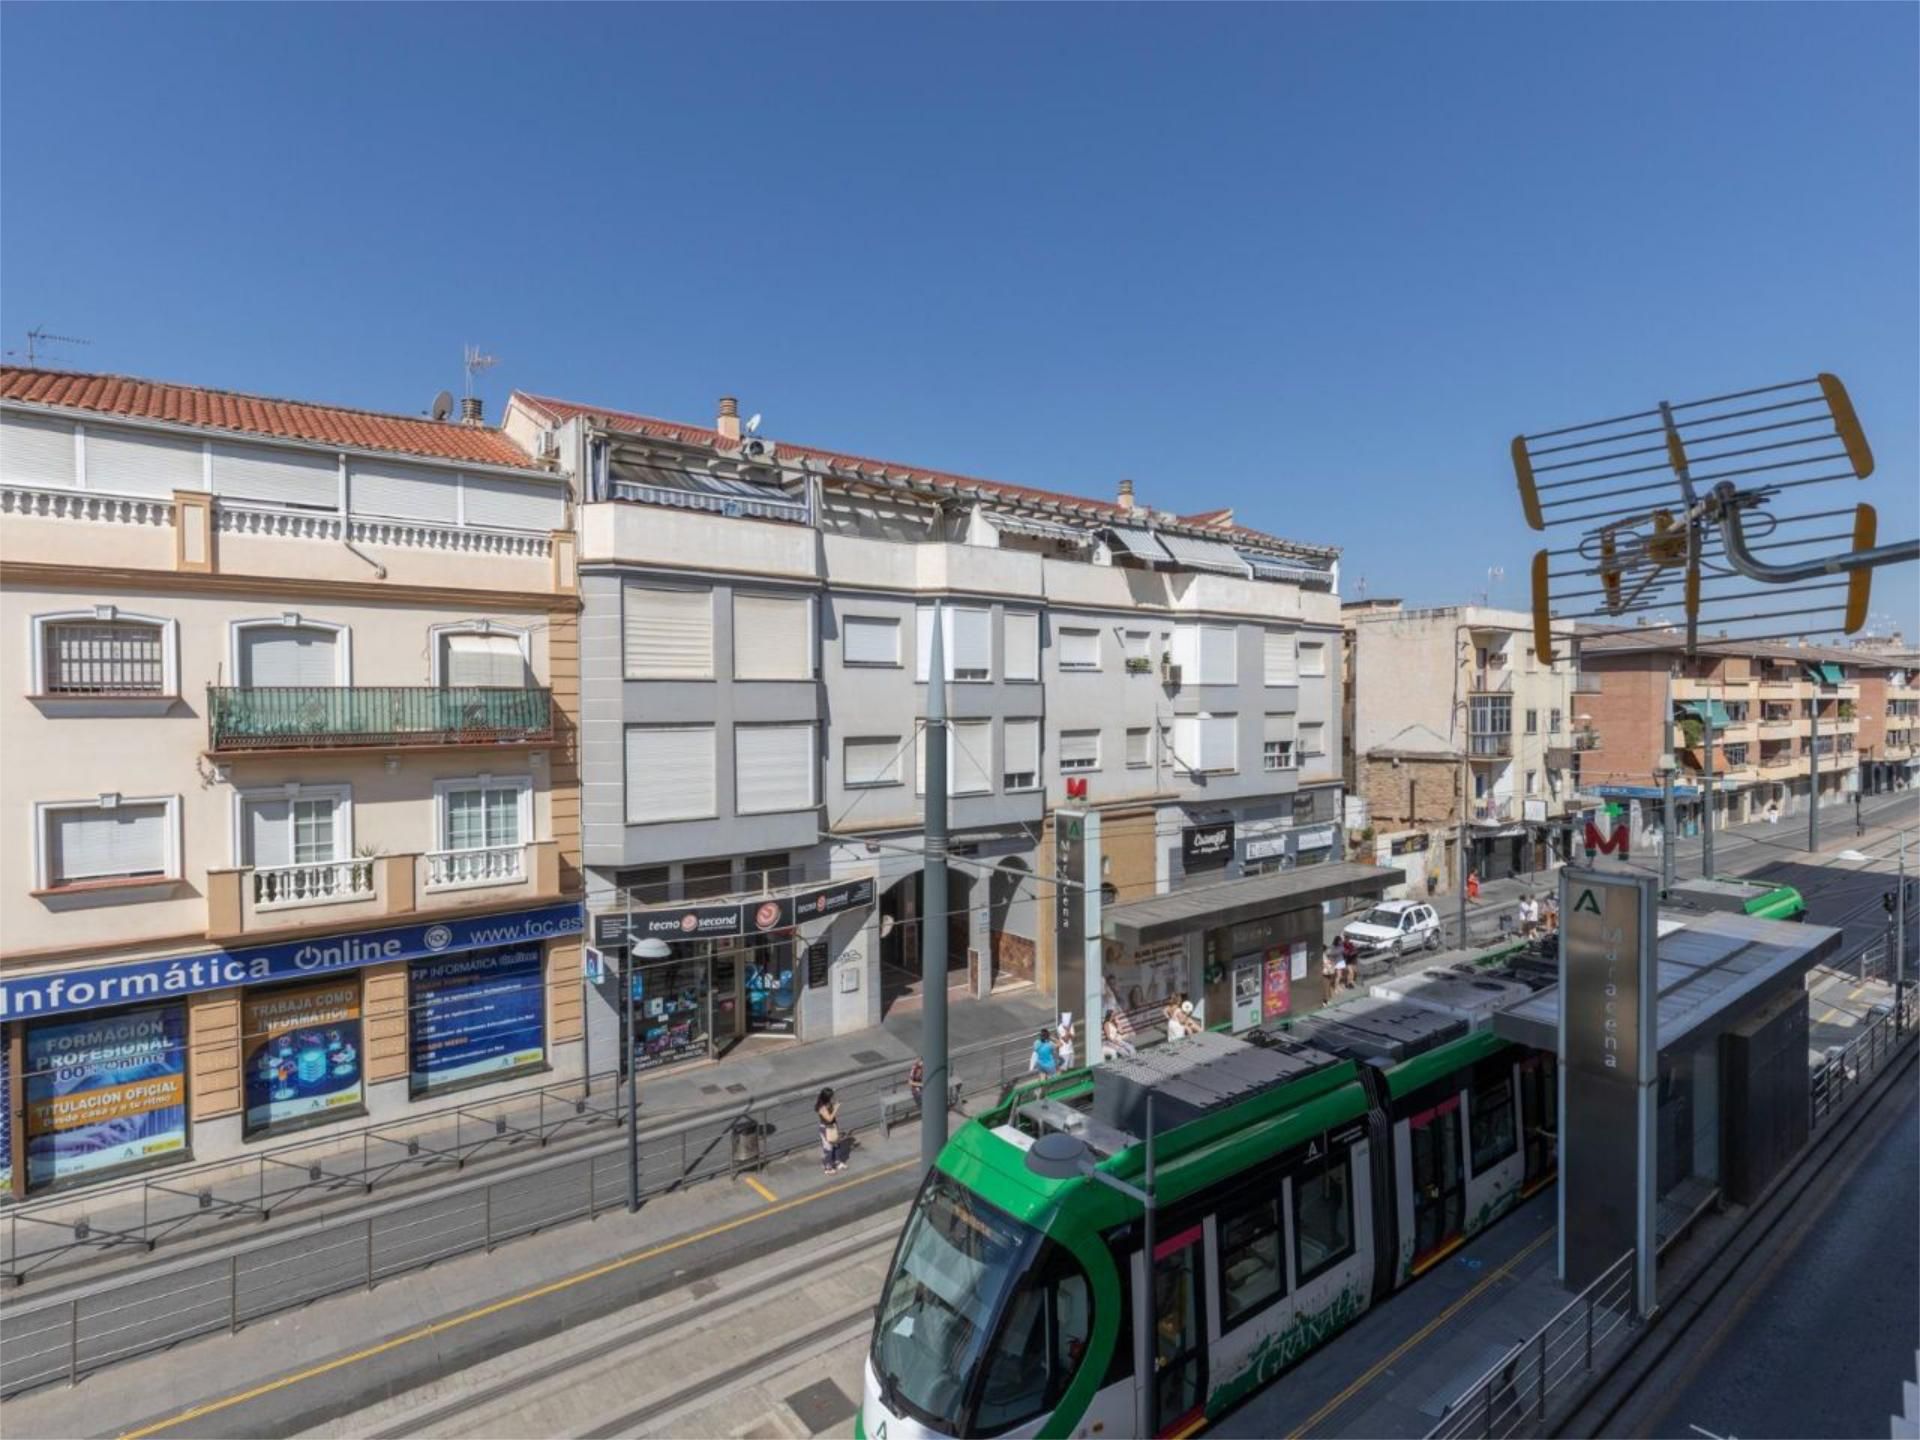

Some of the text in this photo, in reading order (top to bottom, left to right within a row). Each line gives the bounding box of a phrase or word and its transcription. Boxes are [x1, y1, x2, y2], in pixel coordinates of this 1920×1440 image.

[469, 916, 582, 945] www.foc.es
[648, 913, 737, 931] tecno second
[0, 956, 271, 1016] Informática
[253, 991, 353, 1017] TRABAJA COMO
[46, 1019, 164, 1052] FORMACIÓN
[36, 1035, 174, 1071] PROFESIONAL
[126, 1081, 177, 1101] OFICIAL
